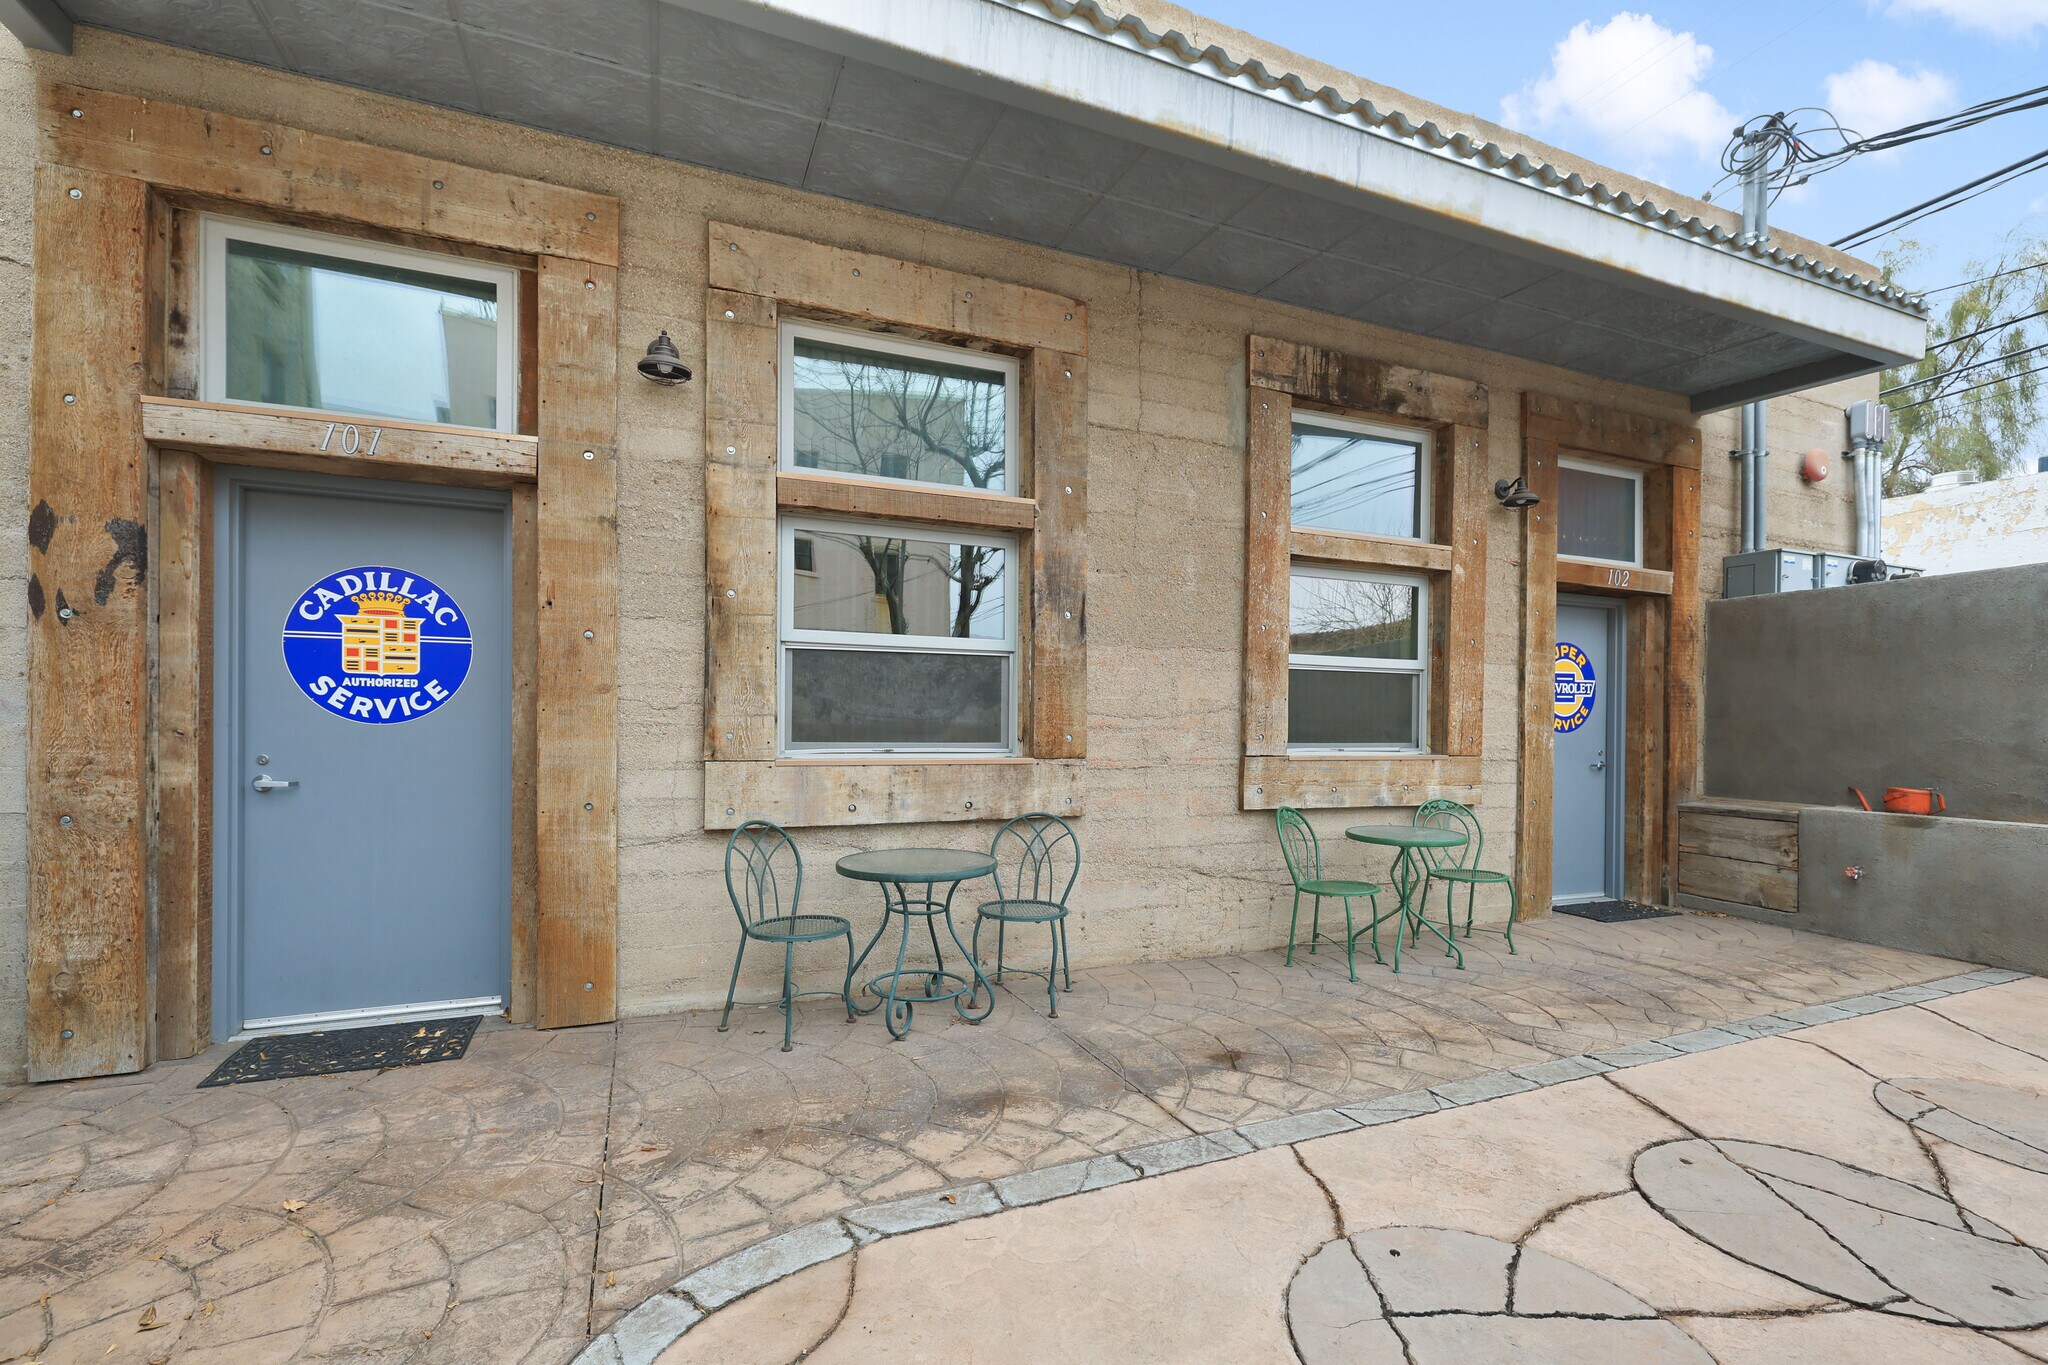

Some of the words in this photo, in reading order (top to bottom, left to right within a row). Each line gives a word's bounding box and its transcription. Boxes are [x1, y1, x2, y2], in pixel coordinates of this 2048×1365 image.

[320, 424, 383, 456] 101
[1608, 569, 1630, 587] 102
[299, 571, 458, 626] CADILLAC
[342, 677, 418, 688] AUTHORIZED
[1555, 683, 1593, 694] VROLET
[309, 675, 449, 719] SERVICE
[1554, 706, 1589, 730] RVICE
